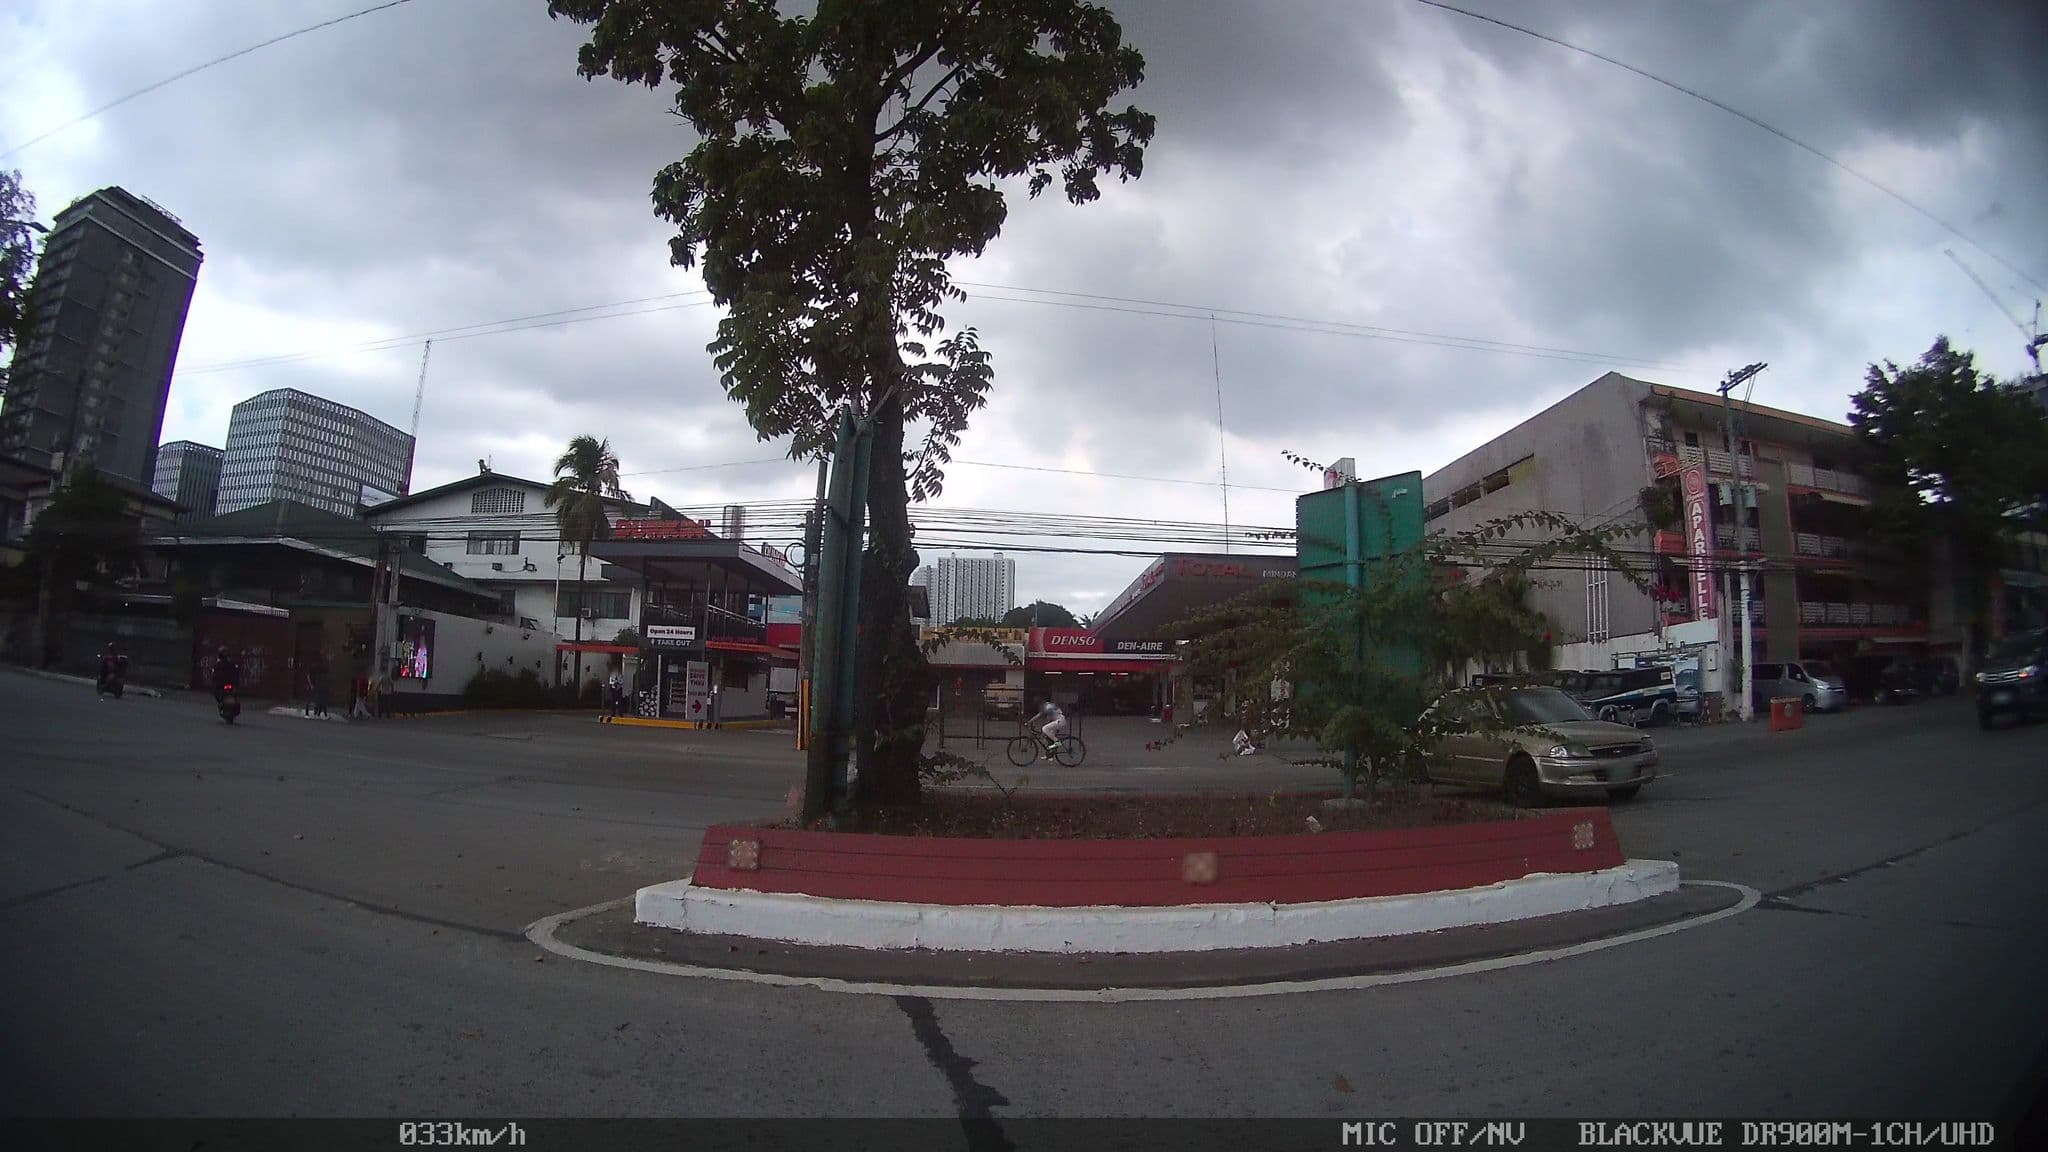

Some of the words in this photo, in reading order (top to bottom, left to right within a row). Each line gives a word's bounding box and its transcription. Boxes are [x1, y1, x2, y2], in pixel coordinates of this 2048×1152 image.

[649, 628, 666, 636] Open
[656, 639, 674, 647] TAKE
[1050, 635, 1097, 646] DENSO
[1117, 640, 1164, 651] DEN-AIRE
